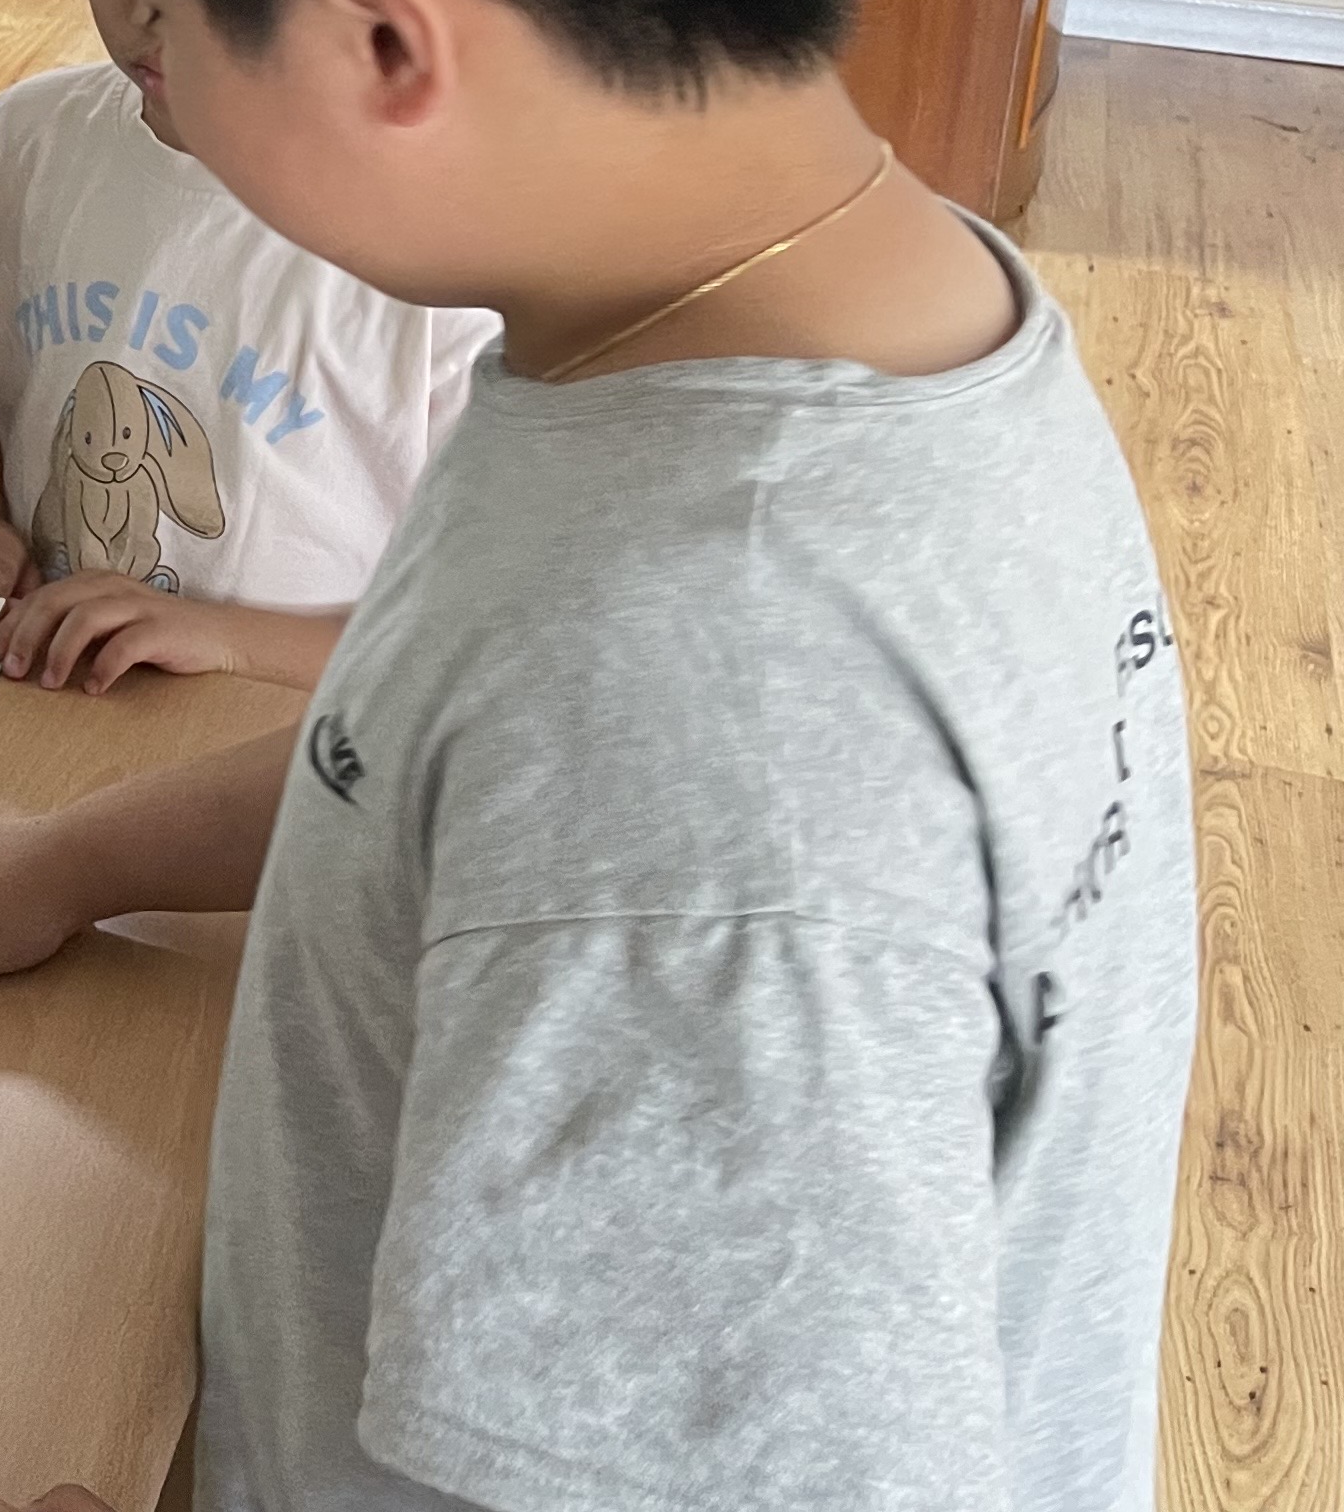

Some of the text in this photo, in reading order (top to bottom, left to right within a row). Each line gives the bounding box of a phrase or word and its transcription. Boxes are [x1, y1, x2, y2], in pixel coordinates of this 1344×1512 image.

[16, 281, 325, 445] THIS IS MY
